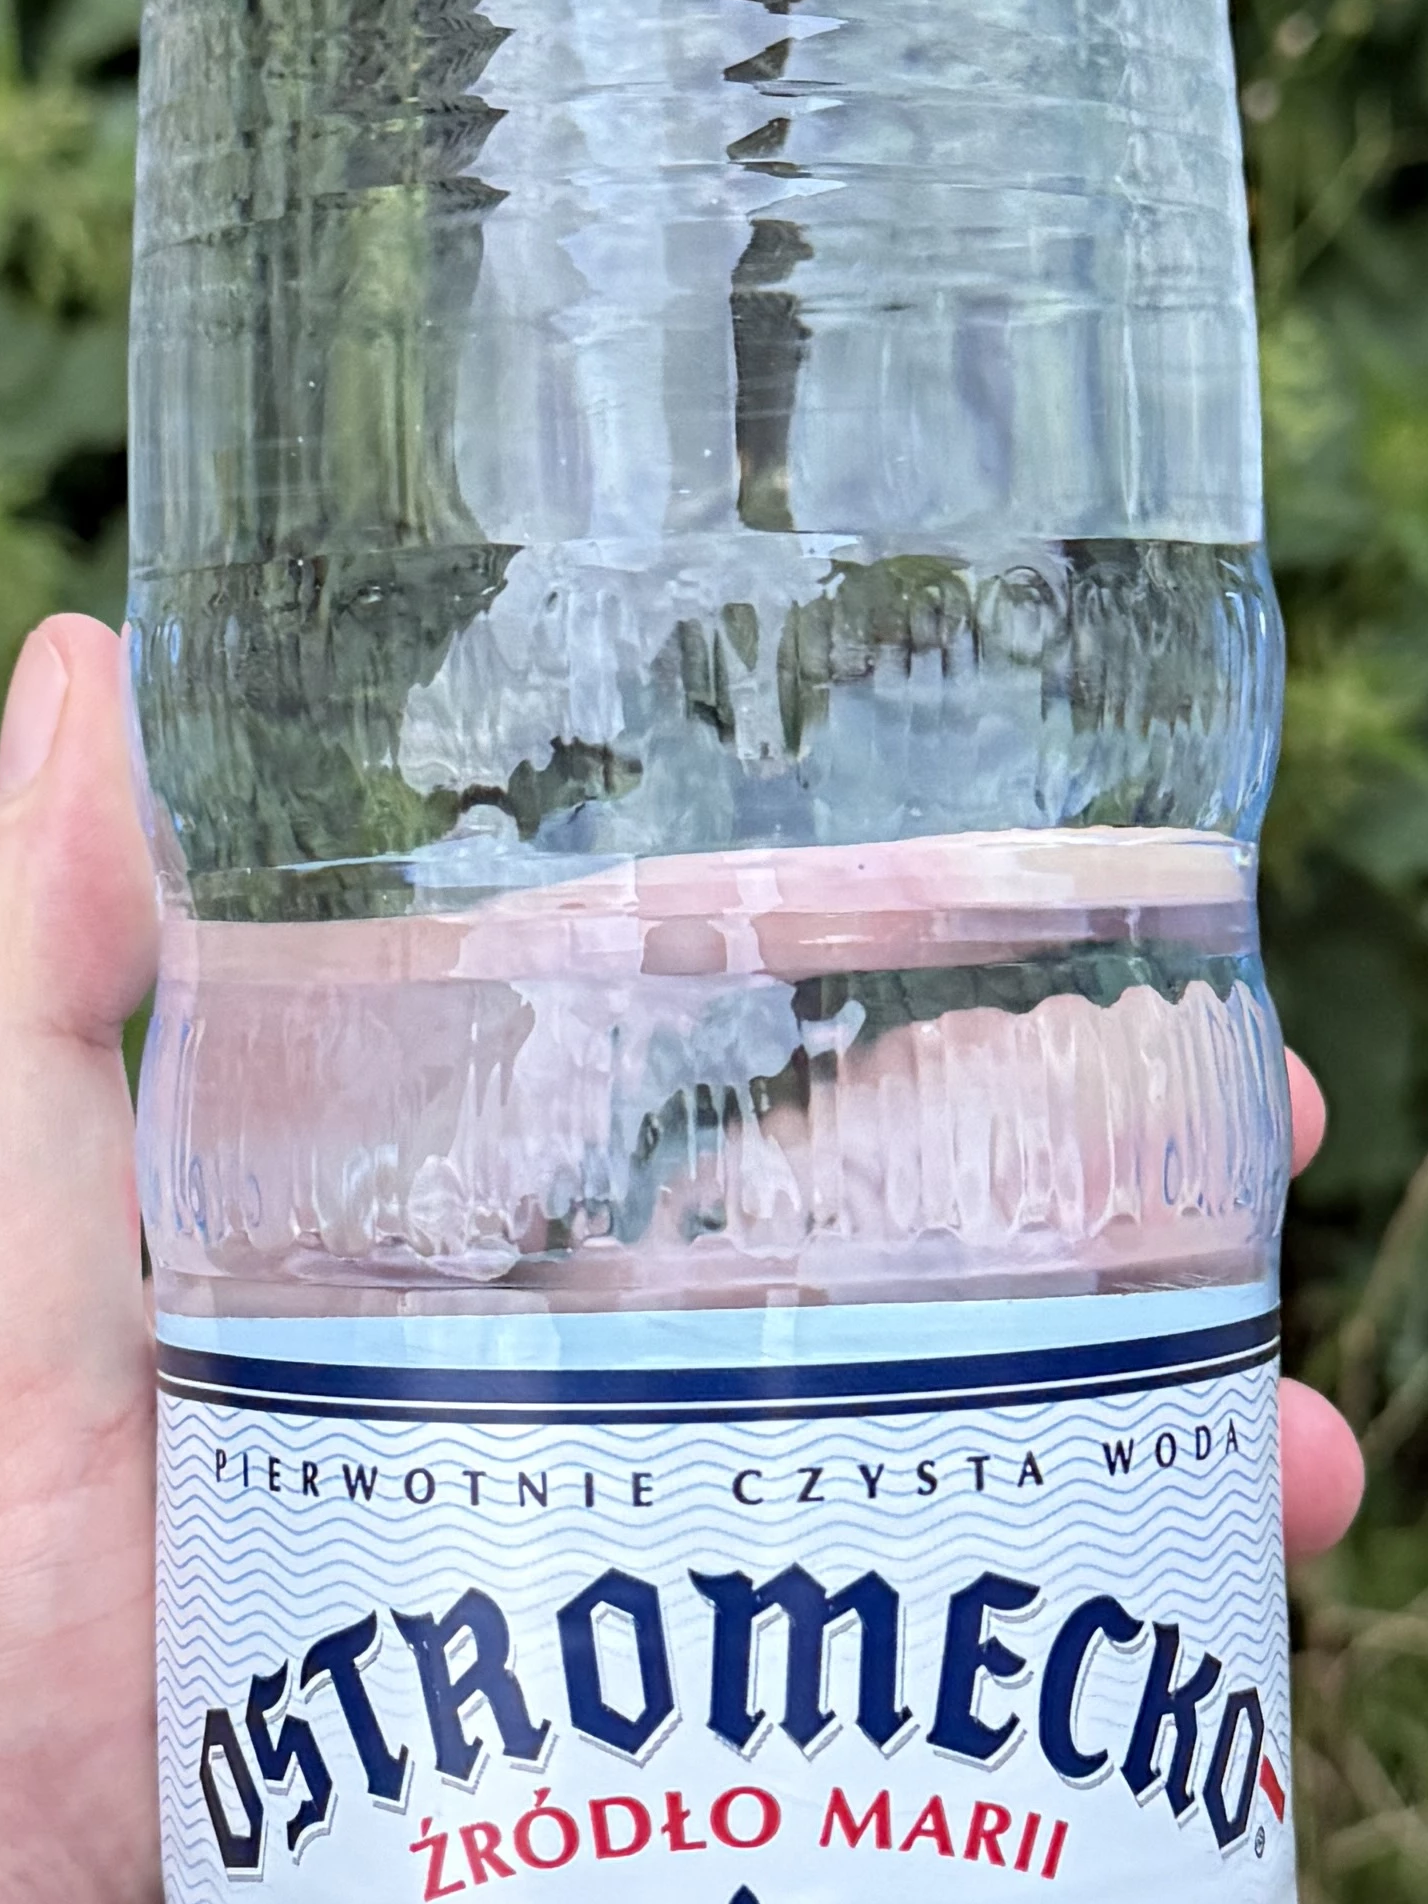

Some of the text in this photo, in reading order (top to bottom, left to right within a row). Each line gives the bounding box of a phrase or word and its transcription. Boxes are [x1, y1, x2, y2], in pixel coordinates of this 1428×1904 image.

[214, 1419, 1241, 1508] PIERWOTNIE CZYSTA WODA
[199, 1563, 1266, 1871] OSTROMECKO
[409, 1786, 1068, 1902] ŹRÓDŁO MARII
